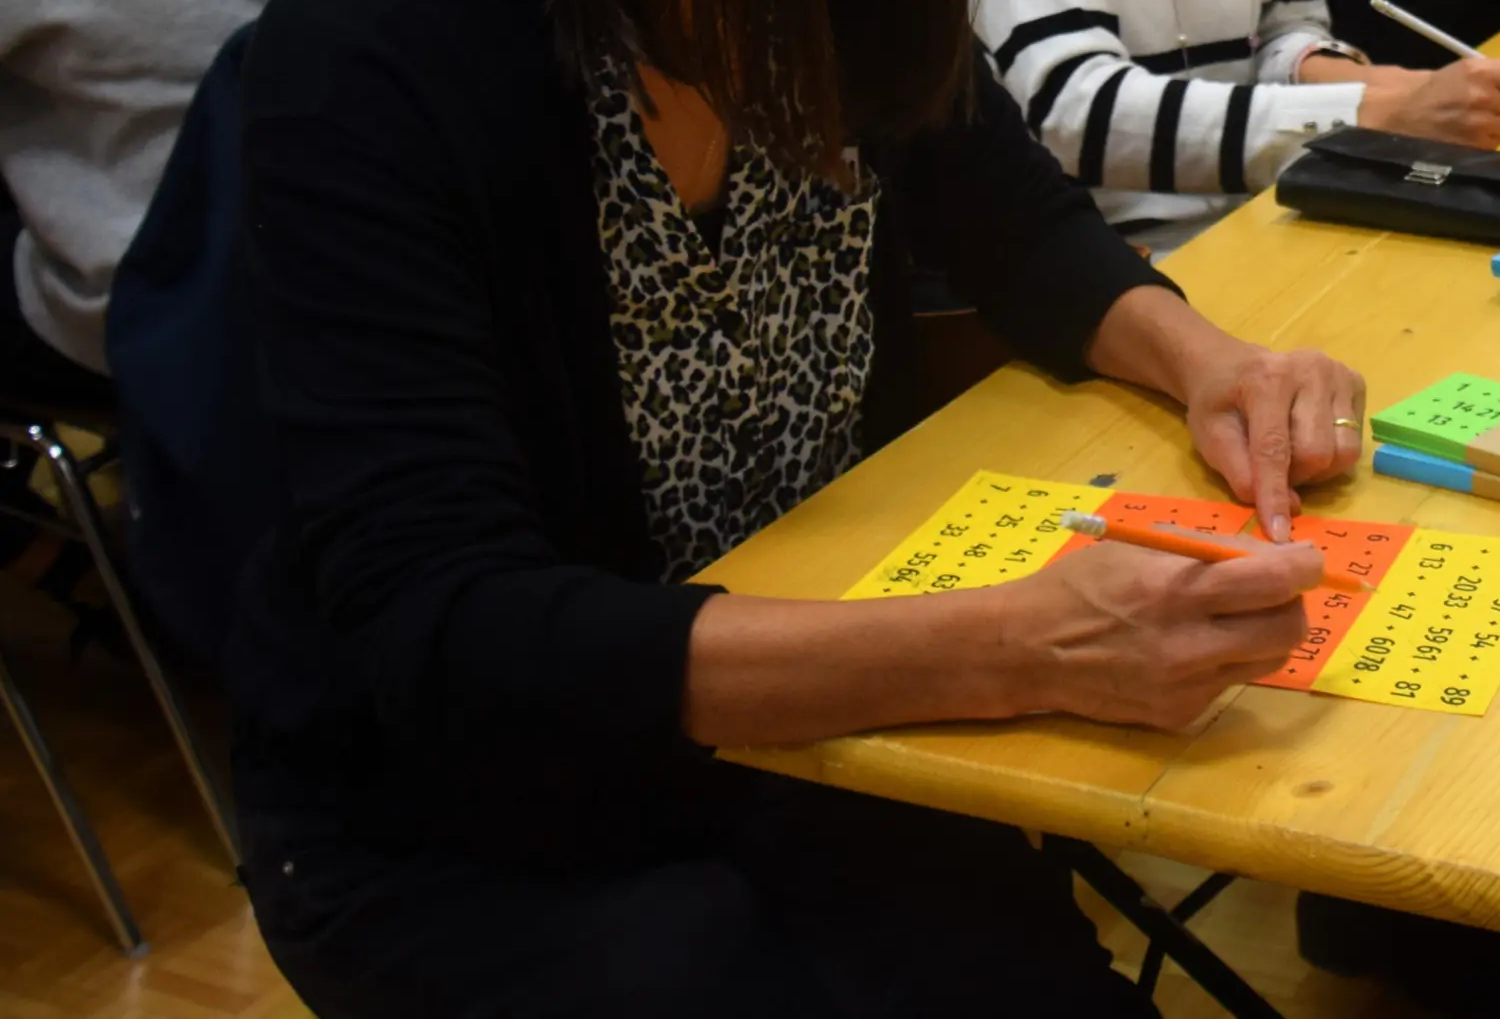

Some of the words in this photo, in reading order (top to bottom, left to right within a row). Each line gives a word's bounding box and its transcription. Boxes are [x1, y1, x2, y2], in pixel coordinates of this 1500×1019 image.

[1457, 383, 1470, 391] 1
[1453, 401, 1474, 412] 14
[1428, 414, 1452, 425] 13
[990, 484, 1011, 492] 7
[995, 514, 1024, 528] 25
[940, 524, 969, 537] 33
[964, 543, 991, 557] 48
[1005, 549, 1032, 562] 41
[907, 552, 937, 566] 55
[1419, 557, 1445, 569] 13
[1346, 561, 1373, 576] 27
[931, 574, 960, 589] 63
[1453, 576, 1482, 592] 20
[1324, 593, 1351, 608] 45
[1444, 593, 1472, 608] 33
[1389, 604, 1415, 620] 47
[1424, 627, 1453, 643] 59
[1470, 632, 1499, 648] 54
[1365, 637, 1395, 654] 60
[1413, 645, 1441, 661] 61
[1354, 655, 1385, 671] 78
[1390, 681, 1421, 698] 81
[1440, 687, 1470, 705] 89
